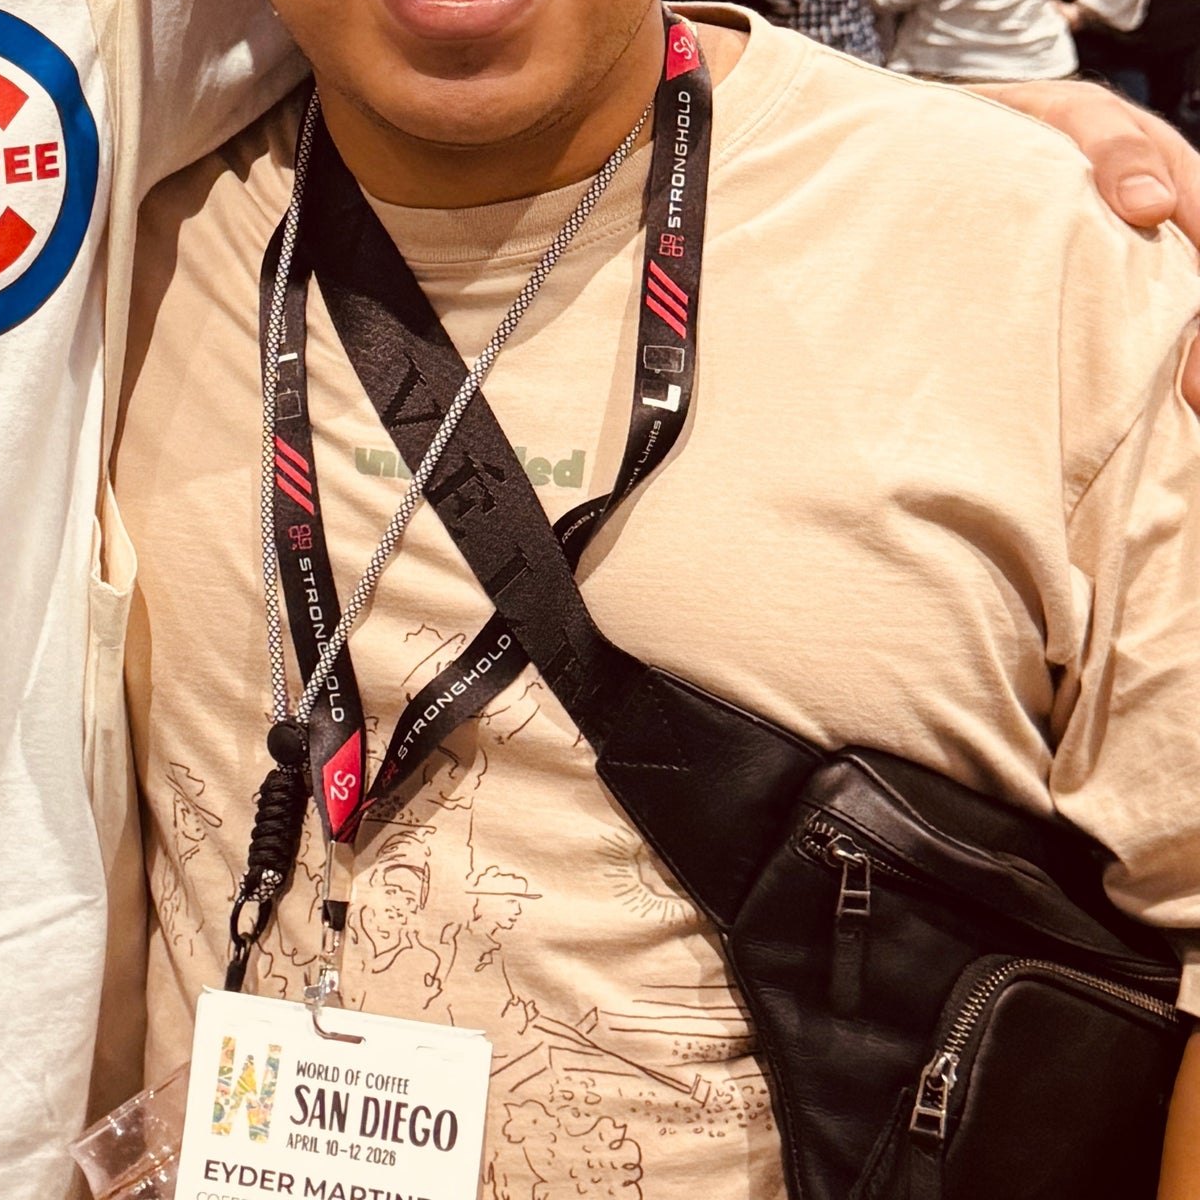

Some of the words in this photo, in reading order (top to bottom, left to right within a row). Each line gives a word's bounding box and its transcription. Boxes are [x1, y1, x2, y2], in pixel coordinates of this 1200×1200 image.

[673, 35, 695, 60] S2
[667, 90, 691, 229] STRONGHOLD
[397, 634, 512, 760] STRONGHOLD
[330, 769, 356, 801] S2
[296, 1060, 340, 1083] WORLD
[345, 1069, 361, 1086] OF
[365, 1072, 410, 1095] COFFEE
[289, 1084, 350, 1133] SAN
[359, 1096, 458, 1152] DIEGO
[286, 1132, 320, 1153] APRIL
[366, 1146, 396, 1166] 2026
[203, 1159, 296, 1195] EYDER
